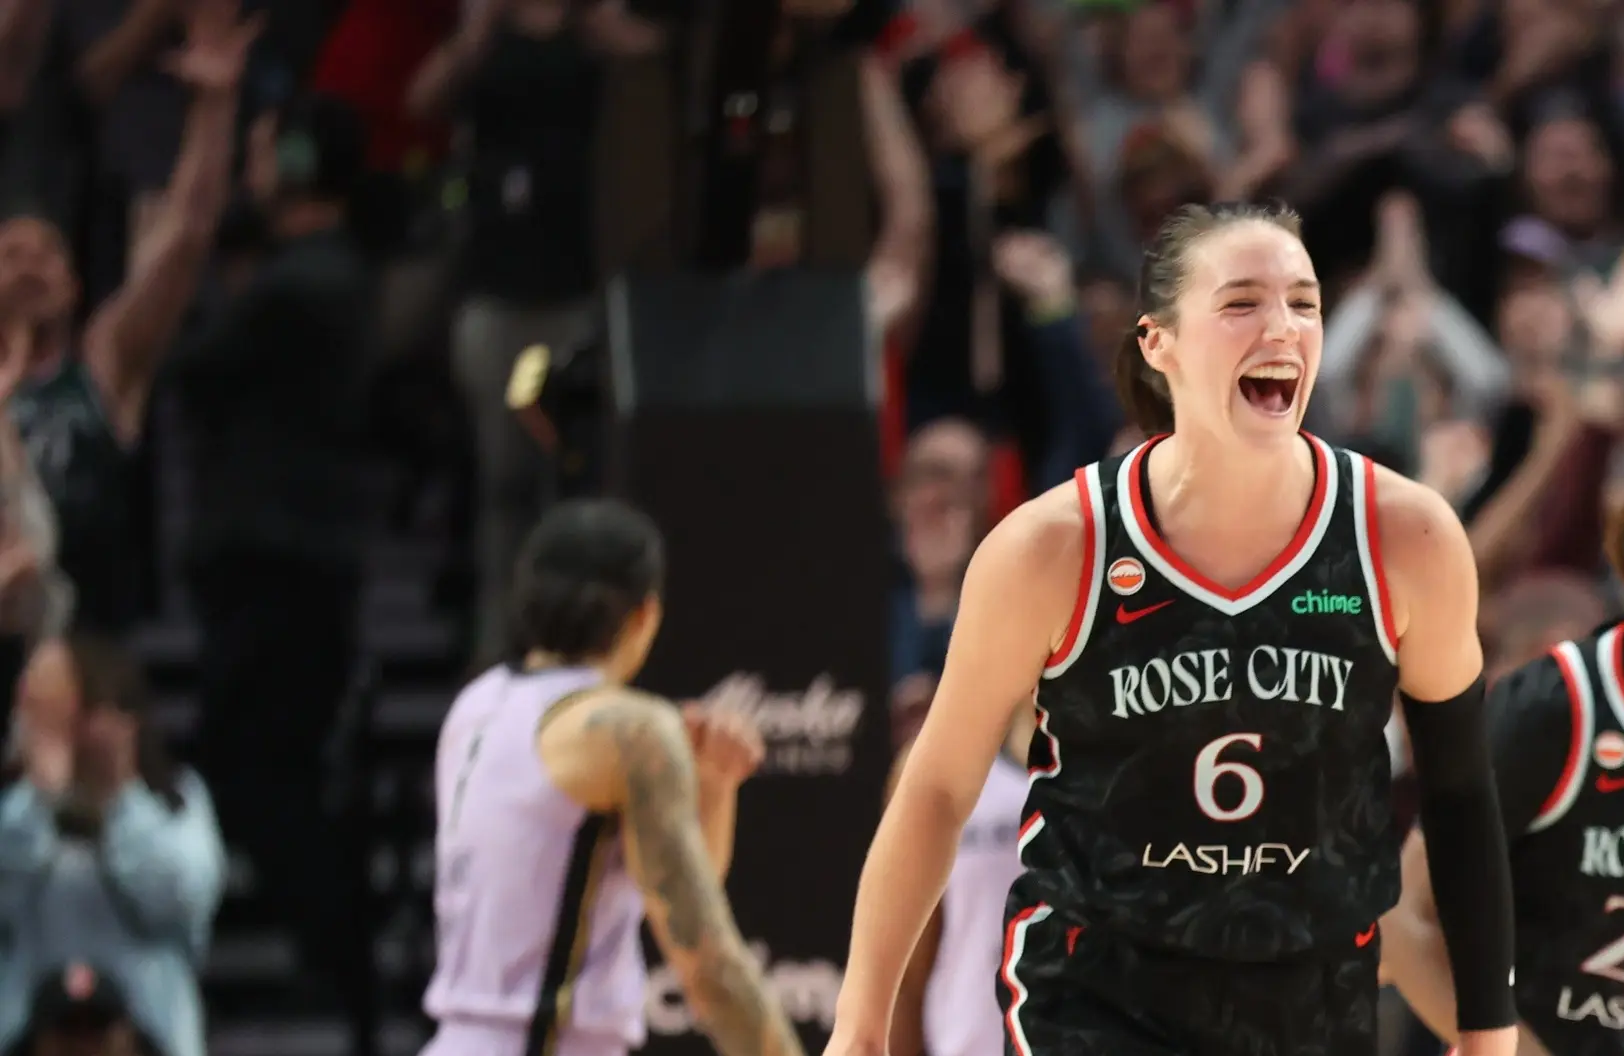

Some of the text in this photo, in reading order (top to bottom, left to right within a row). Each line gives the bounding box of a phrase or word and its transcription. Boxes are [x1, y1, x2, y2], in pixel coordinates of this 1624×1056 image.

[1291, 588, 1362, 614] chime
[1109, 644, 1353, 719] ROSE CITY
[1194, 732, 1264, 821] 6
[1142, 842, 1311, 876] LASHIFY
